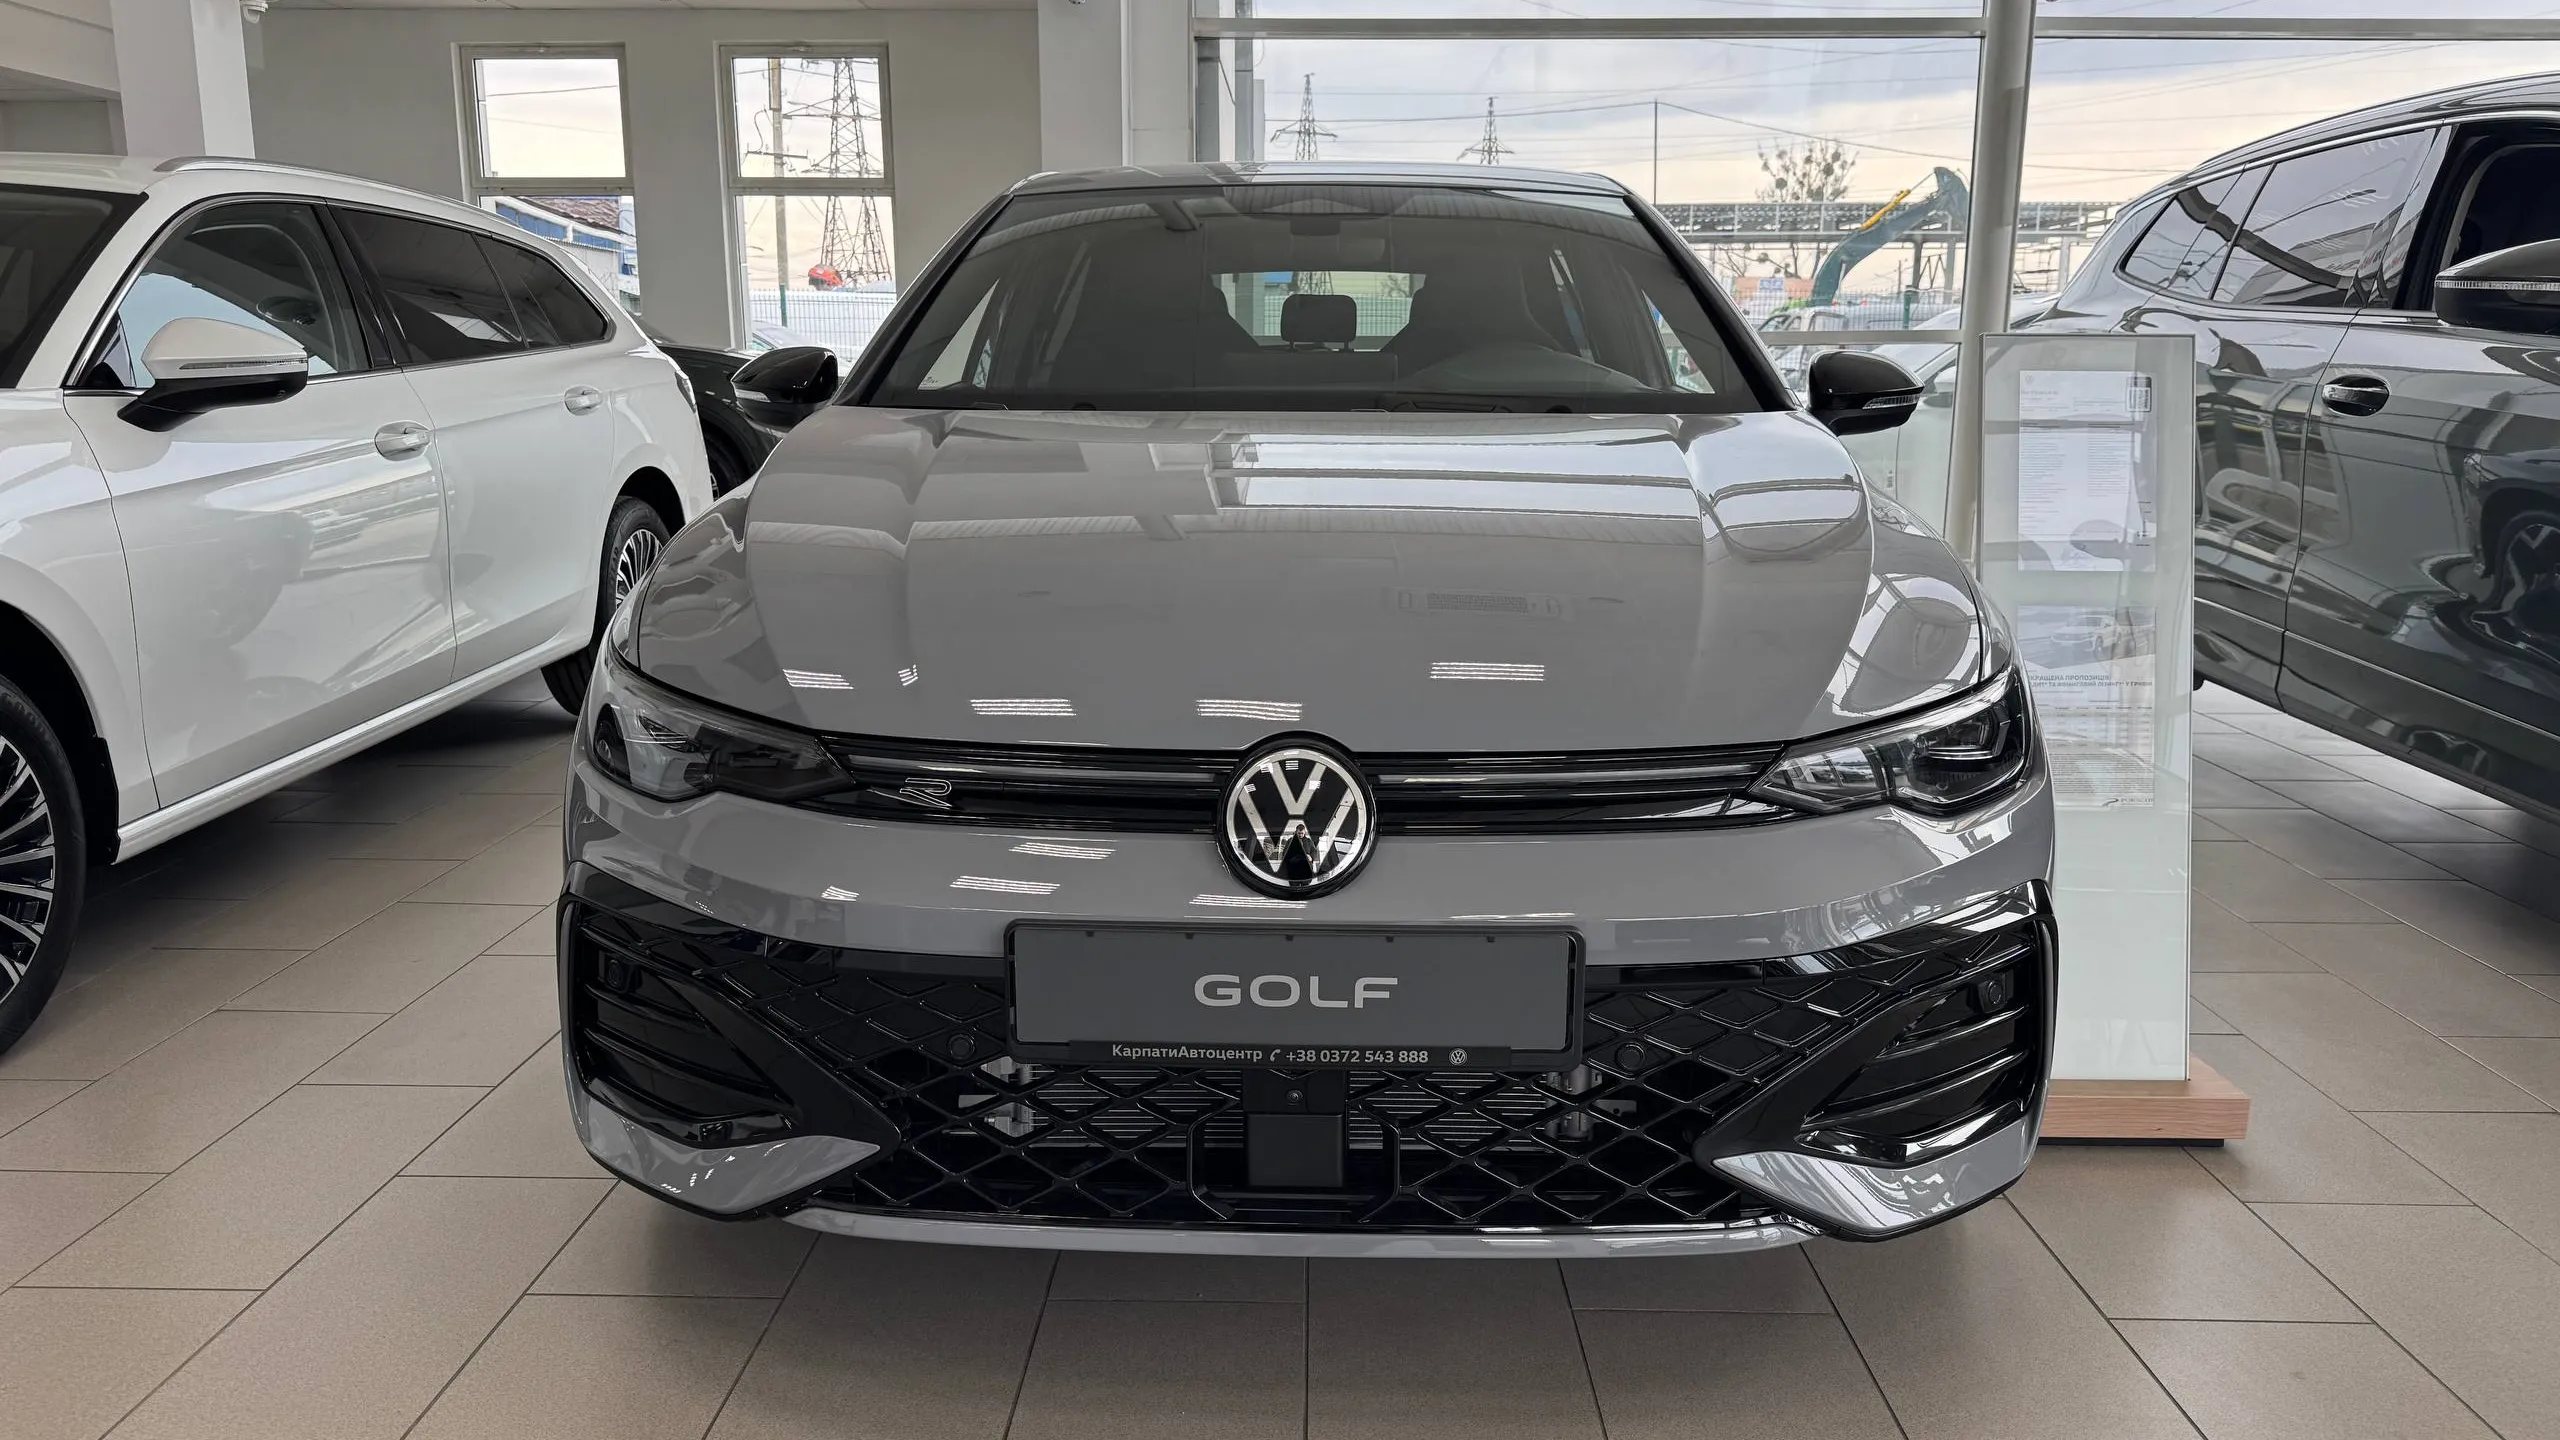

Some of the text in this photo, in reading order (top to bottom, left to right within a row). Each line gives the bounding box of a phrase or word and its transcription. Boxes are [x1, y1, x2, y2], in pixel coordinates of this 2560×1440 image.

[1194, 974, 1398, 1009] GOLF
[1112, 1044, 1429, 1063] КарпатиАвтоцентр +38 0372 543 888
